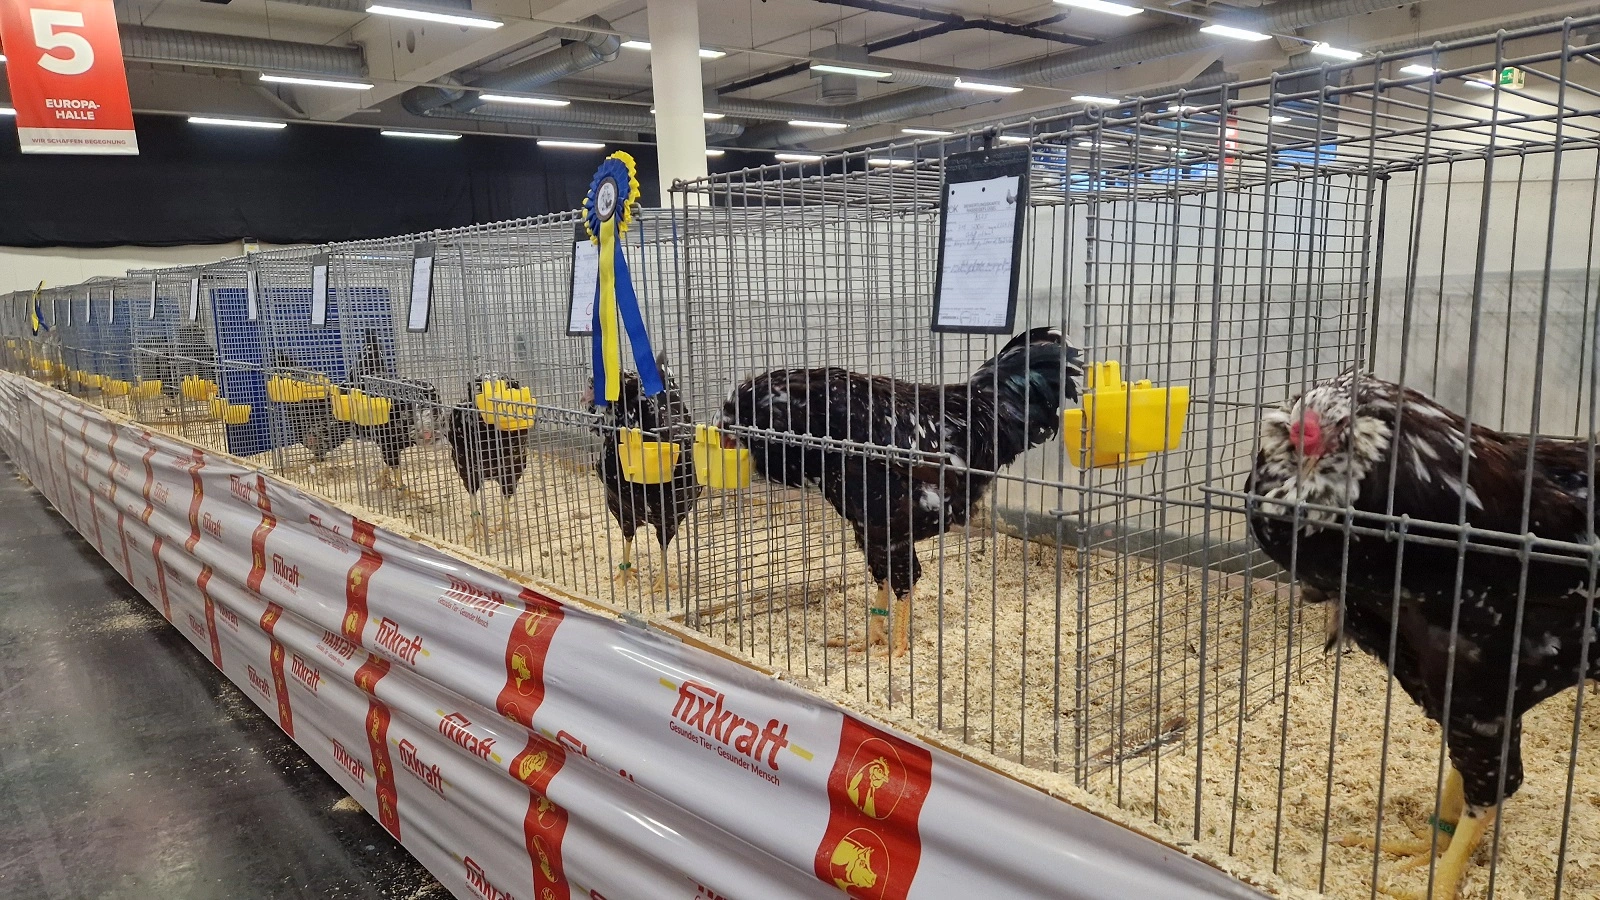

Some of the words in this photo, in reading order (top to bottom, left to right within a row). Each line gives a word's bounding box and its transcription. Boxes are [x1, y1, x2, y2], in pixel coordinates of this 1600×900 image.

[30, 8, 95, 75] 5
[45, 98, 101, 110] EUROPA-
[55, 110, 95, 120] HALLE
[272, 552, 300, 588] fixkraft
[374, 616, 423, 666] fixkraft
[671, 679, 789, 771] fixkraft
[398, 738, 444, 794] fixkraft
[669, 721, 699, 744] Gesundes
[699, 735, 713, 751] Tier
[717, 746, 751, 772] Gesunder
[751, 763, 780, 786] Mensch
